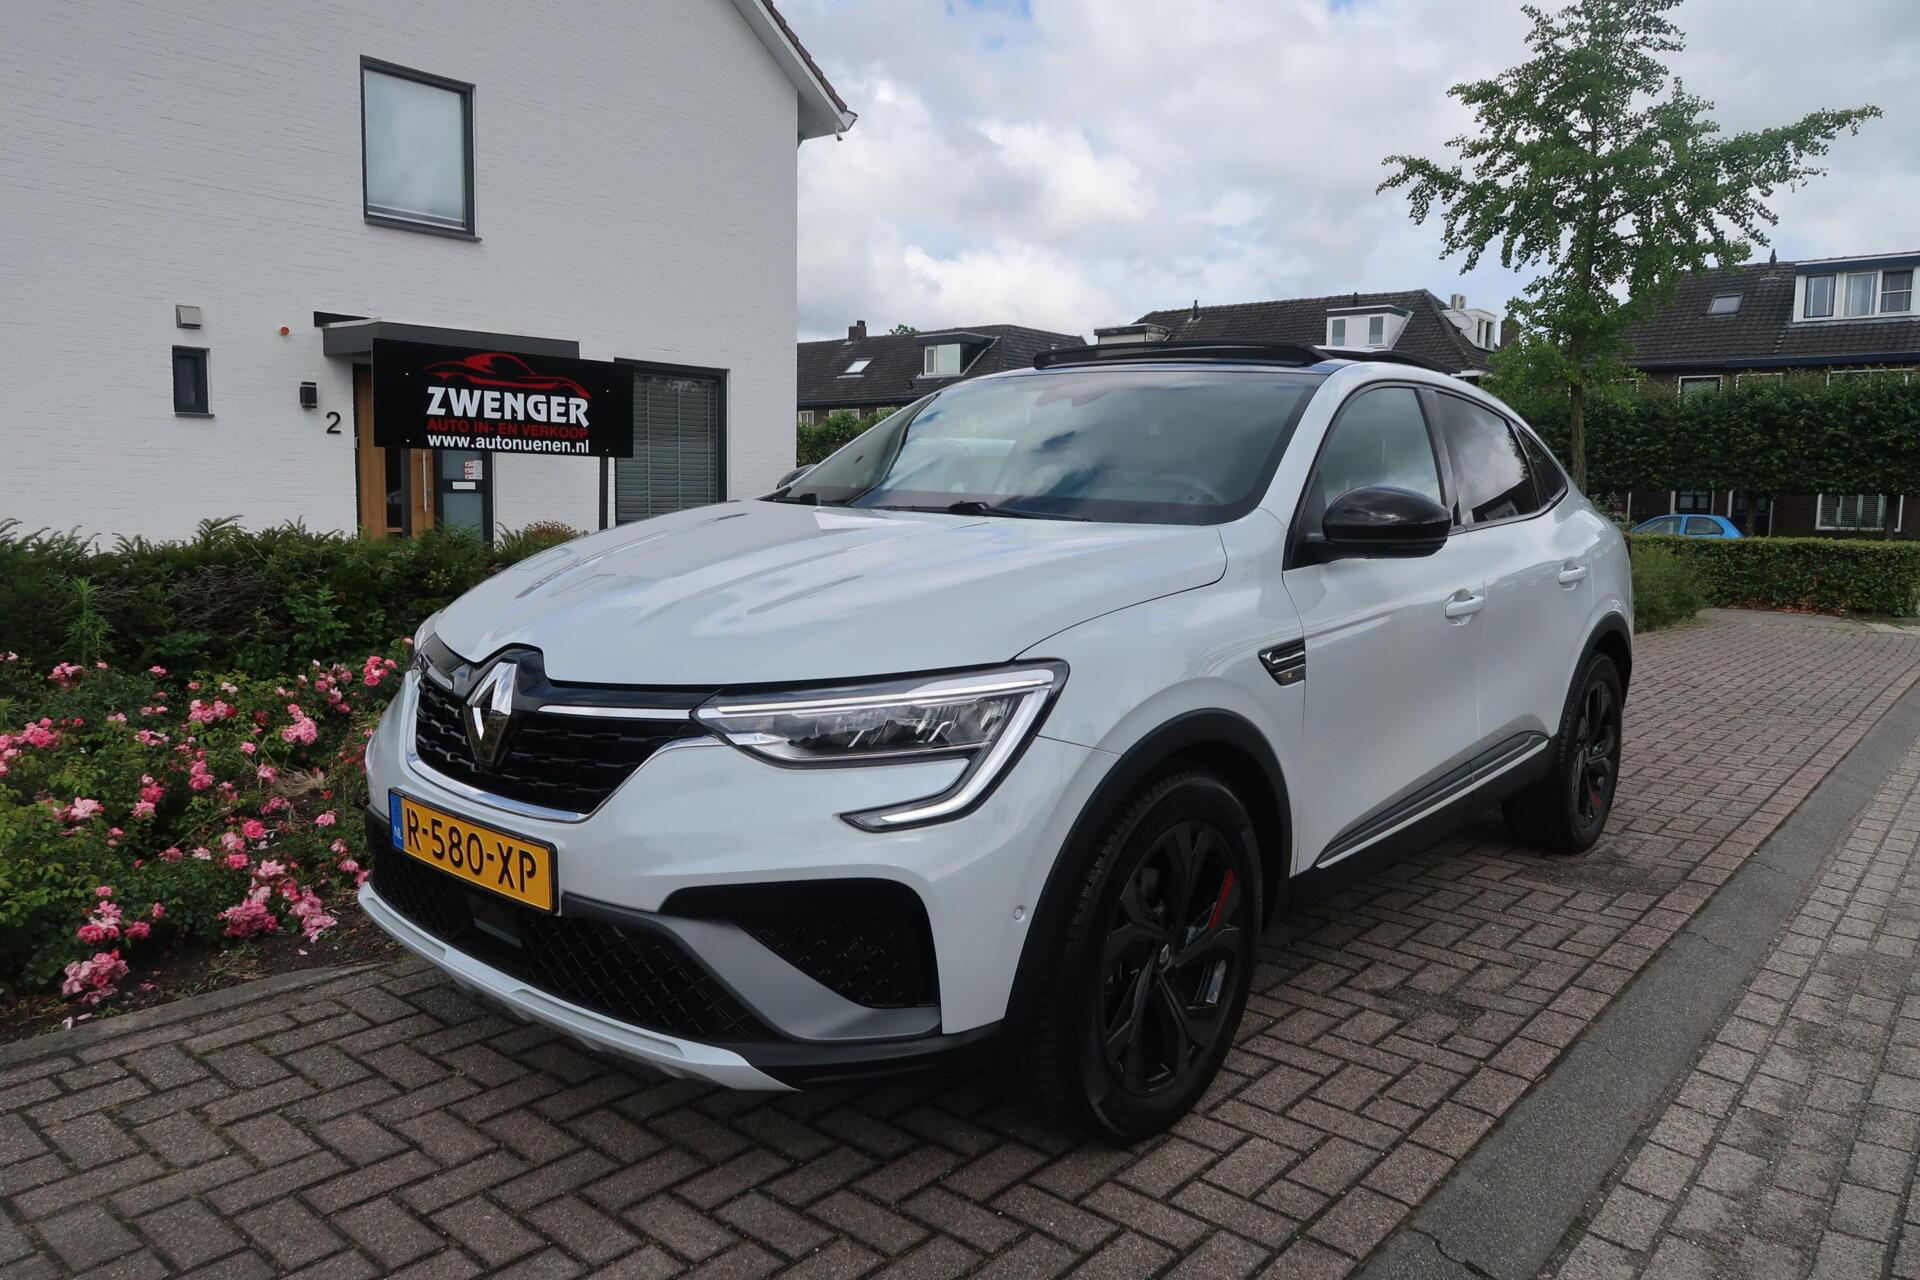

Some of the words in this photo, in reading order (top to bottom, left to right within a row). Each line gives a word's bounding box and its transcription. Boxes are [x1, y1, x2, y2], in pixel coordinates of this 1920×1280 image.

[426, 386, 590, 428] ZWENGER
[326, 411, 342, 434] 2
[427, 418, 470, 433] AUTO
[474, 422, 493, 434] IN-
[498, 423, 518, 436] EN
[521, 425, 589, 439] VERKOOP
[427, 434, 589, 453] www.autonuenen.nl
[393, 825, 403, 840] NL
[406, 807, 537, 893] R-580-XP
